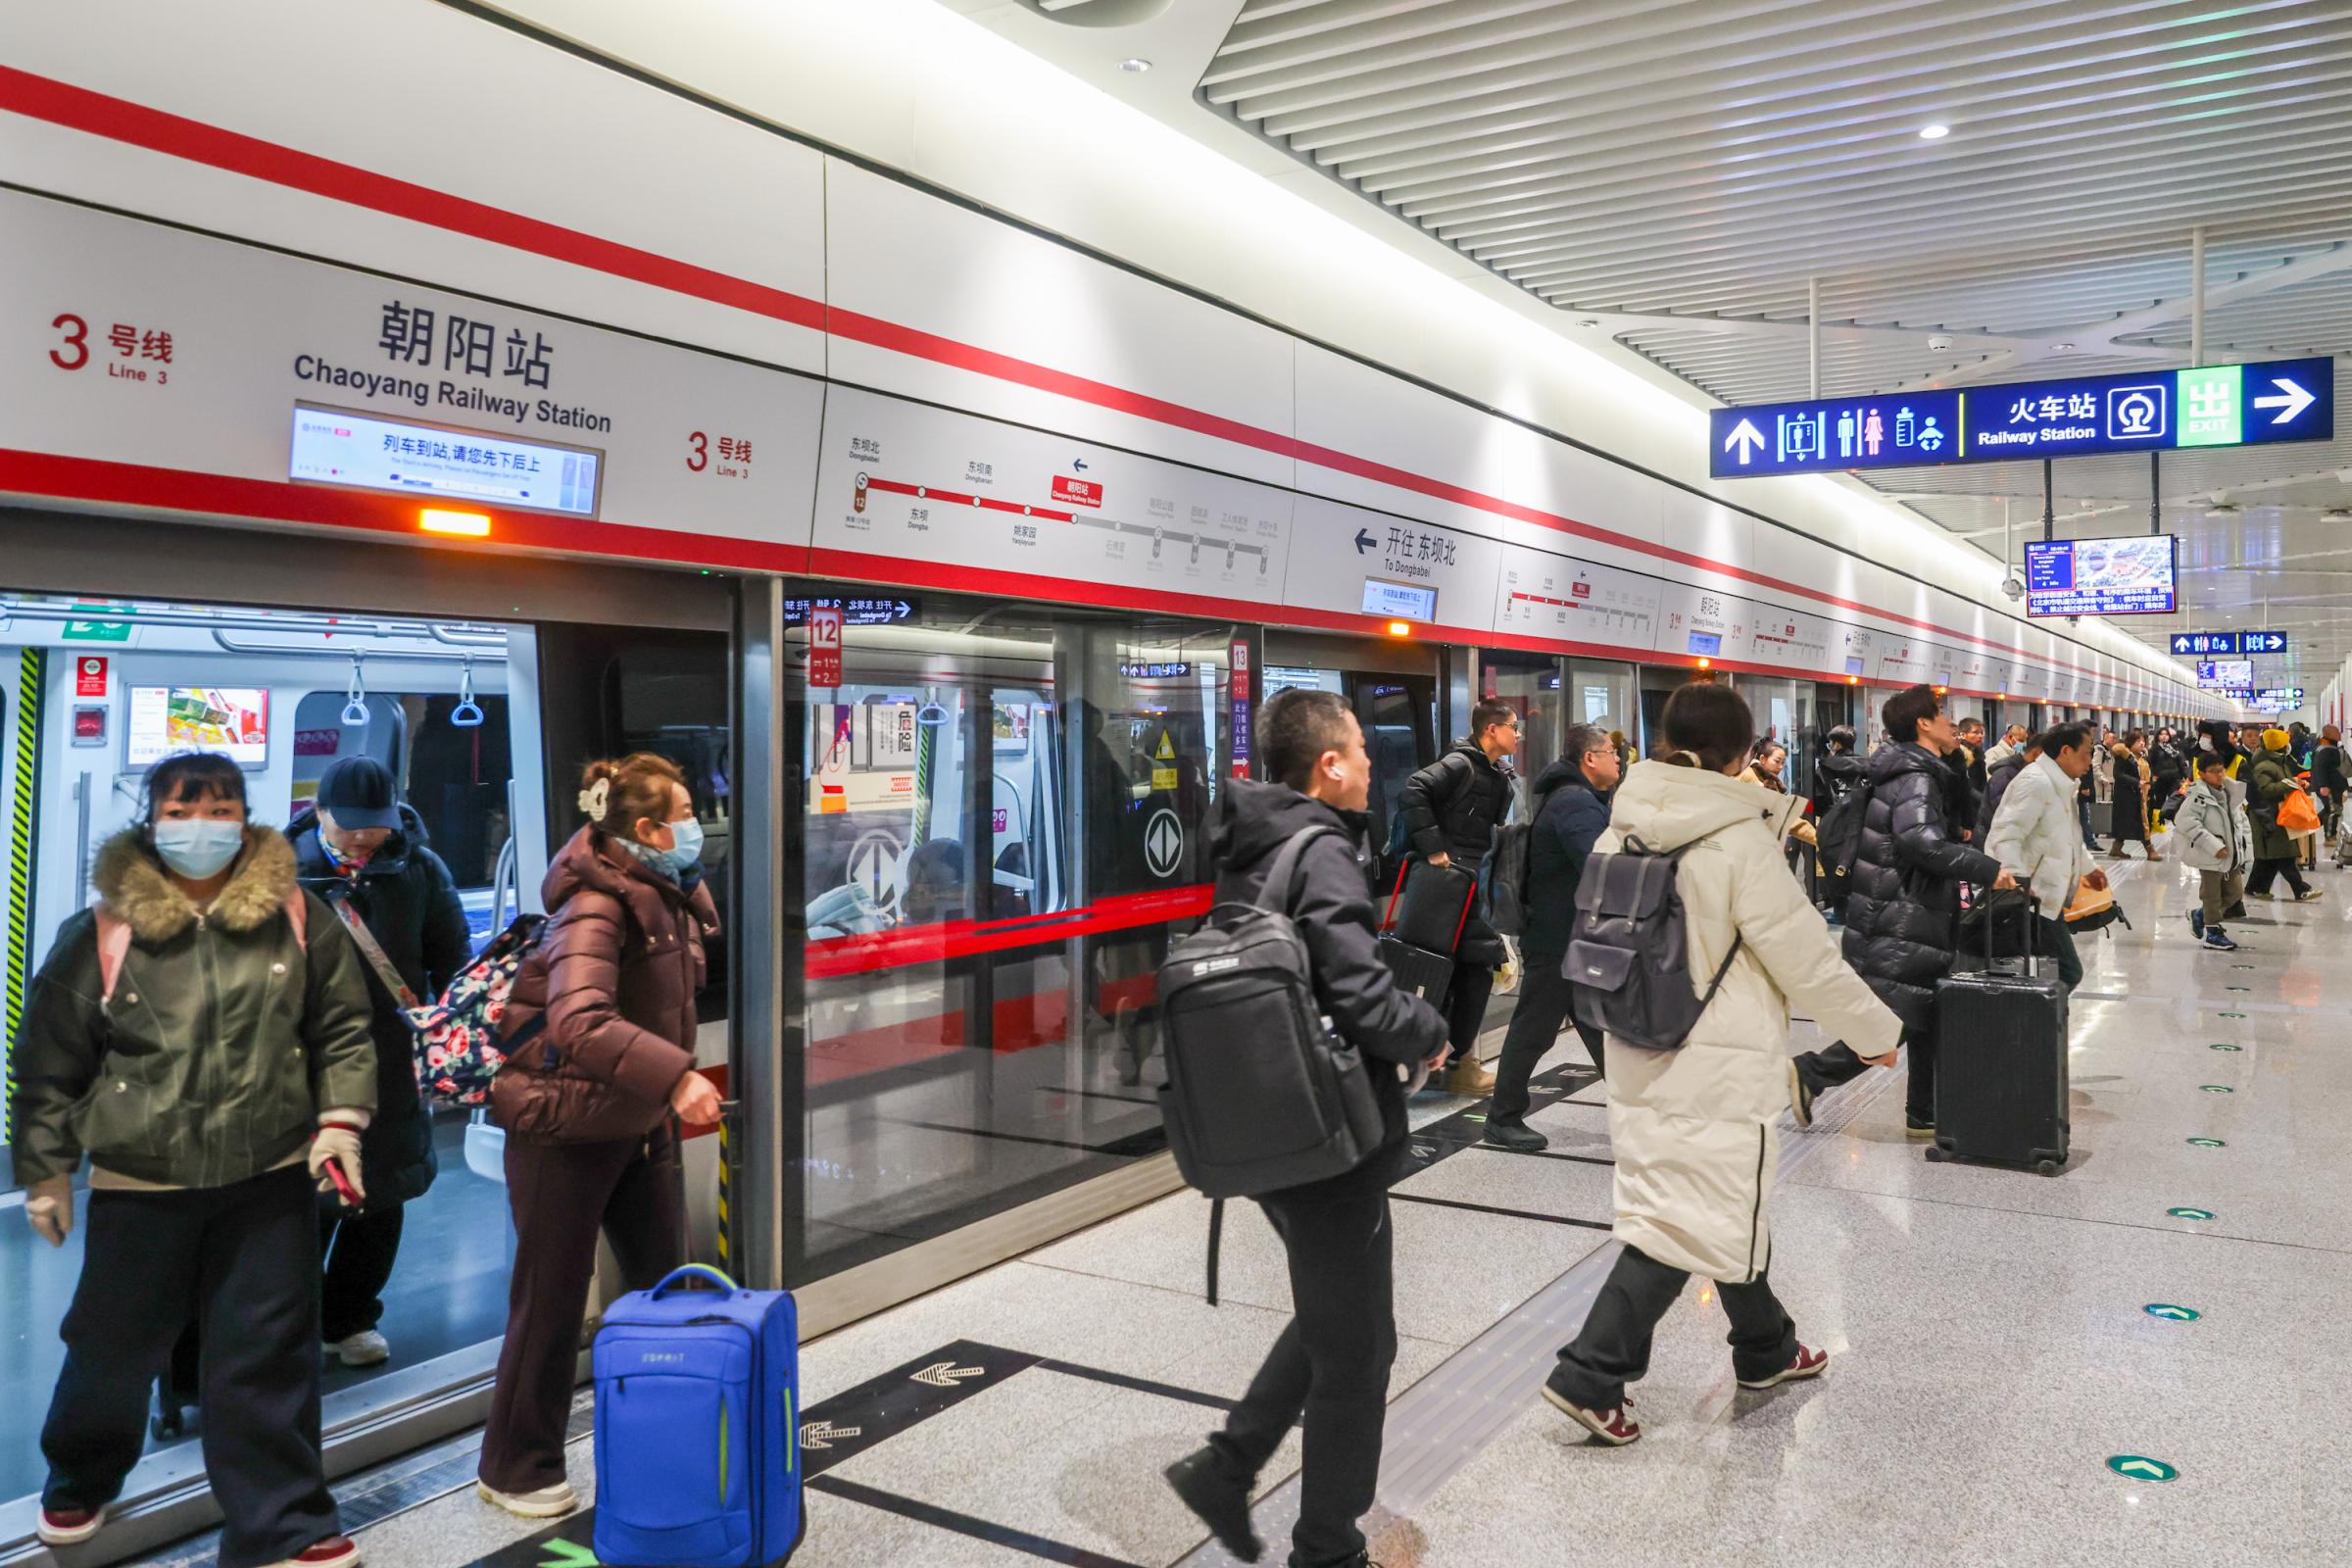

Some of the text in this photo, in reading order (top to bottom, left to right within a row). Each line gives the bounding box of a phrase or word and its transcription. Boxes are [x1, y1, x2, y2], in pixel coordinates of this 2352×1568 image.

[49, 313, 172, 370] 3 号线
[379, 300, 554, 390] 朝阳站
[109, 363, 168, 385] Line 3
[294, 355, 612, 433] Chaoyang Railway Station
[2188, 381, 2230, 418] 出
[2008, 393, 2097, 424] 火车站
[1979, 425, 2096, 446] Railway Station
[2188, 418, 2230, 433] EXIT
[383, 434, 541, 472] 列车到站,请您先下后上
[686, 431, 752, 471] 3 号线
[851, 437, 880, 454] 东坝北
[716, 465, 749, 479] Line 3
[968, 461, 993, 476] 东坝南
[856, 497, 864, 508] 12
[910, 508, 928, 521] 东坝
[1386, 527, 1456, 566] 开往 东坝北
[1385, 559, 1431, 578] To Dongbabei
[815, 619, 836, 642] 12
[1235, 650, 1246, 666] 13
